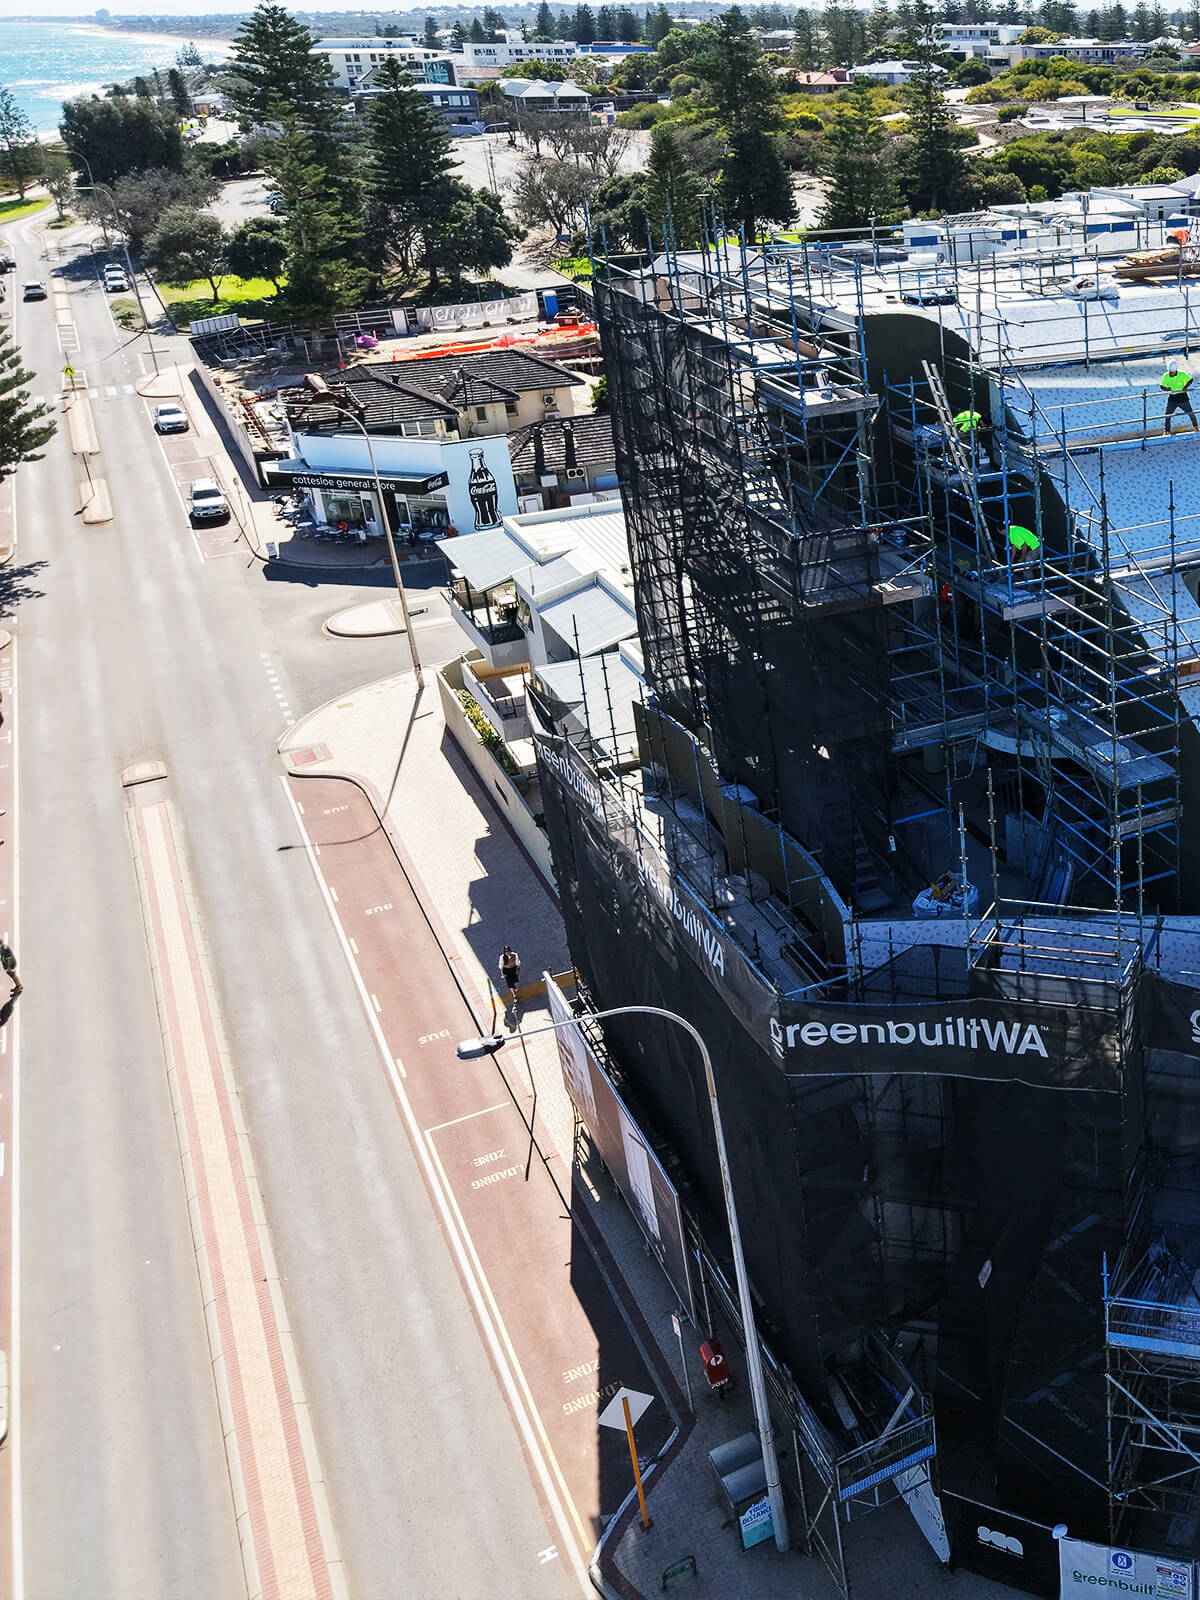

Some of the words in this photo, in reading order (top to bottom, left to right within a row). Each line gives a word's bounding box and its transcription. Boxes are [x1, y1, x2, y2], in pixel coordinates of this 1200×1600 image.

[291, 475, 335, 487] cottesloe
[336, 479, 371, 490] general
[372, 483, 396, 492] sore
[322, 804, 349, 815] BUS
[365, 903, 393, 916] BUS
[418, 1029, 451, 1046] BUS
[473, 1148, 506, 1167] ZONE
[471, 1164, 525, 1191] LOADING
[562, 1359, 601, 1383] ZONE
[711, 1377, 729, 1390] POST
